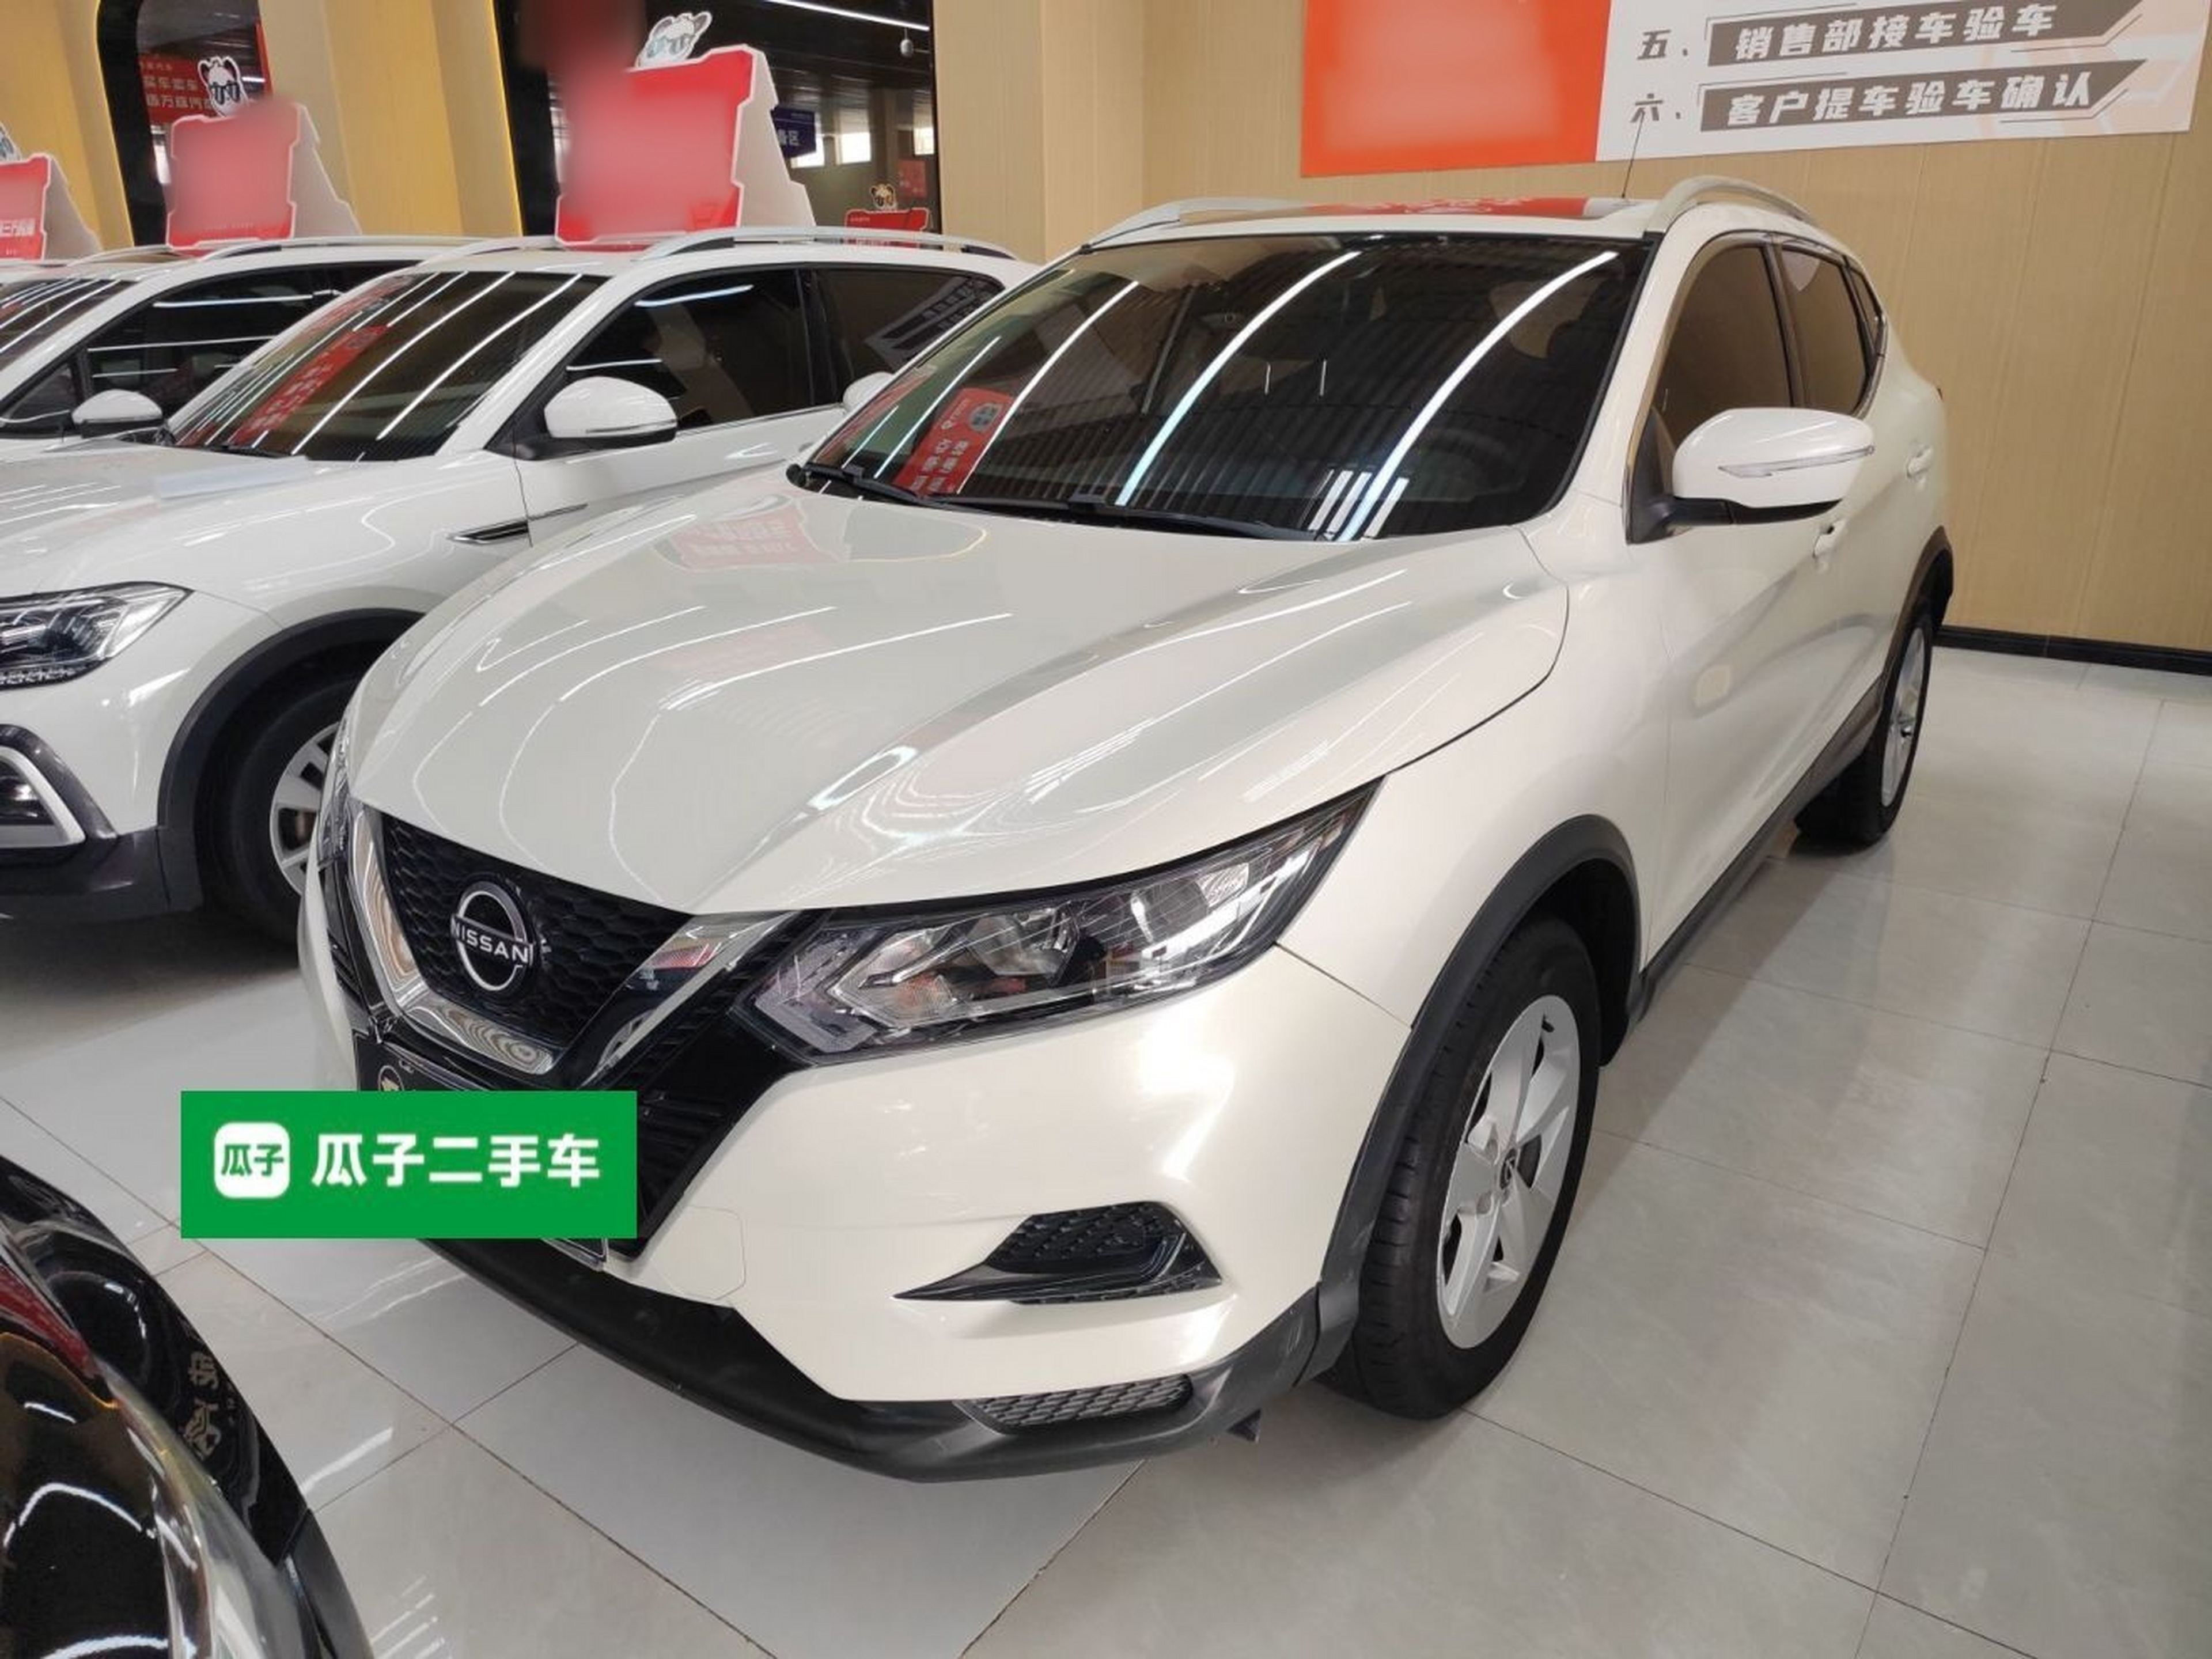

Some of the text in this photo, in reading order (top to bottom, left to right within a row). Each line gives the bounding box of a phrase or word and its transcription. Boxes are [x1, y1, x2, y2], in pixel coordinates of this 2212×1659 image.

[1735, 4, 2056, 60] 销售部接车验车
[1728, 71, 2092, 126] 客户提车验车确认
[453, 922, 528, 963] NISSAN
